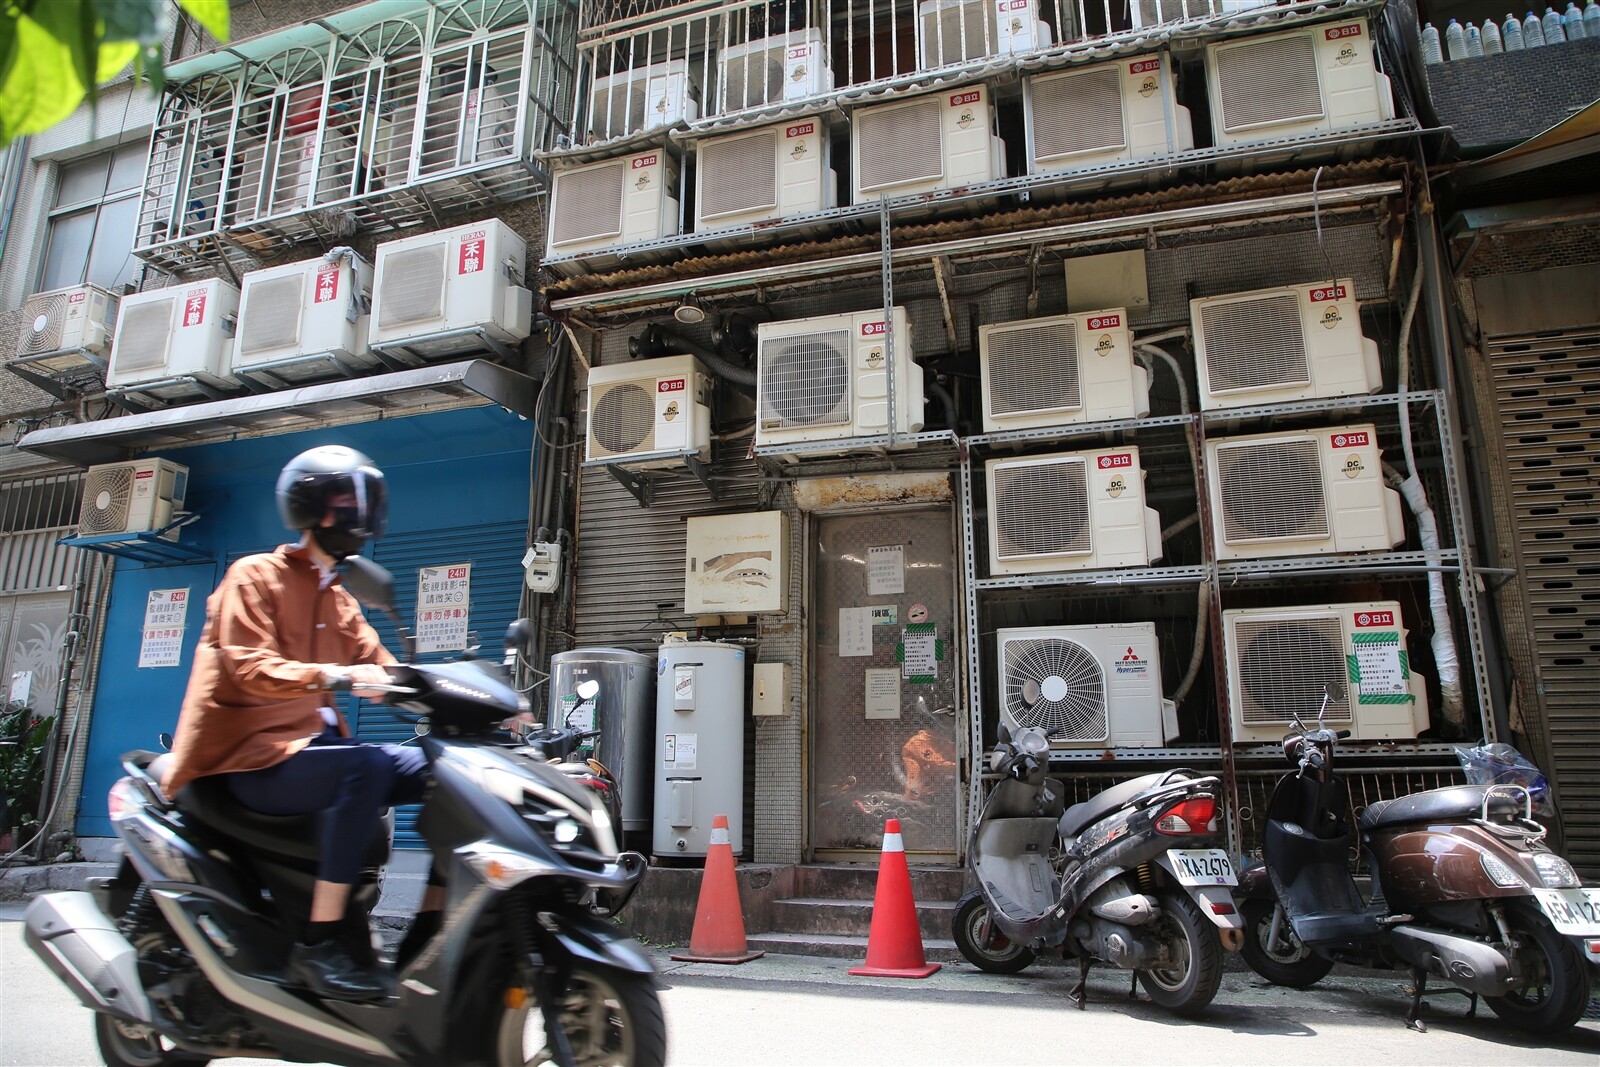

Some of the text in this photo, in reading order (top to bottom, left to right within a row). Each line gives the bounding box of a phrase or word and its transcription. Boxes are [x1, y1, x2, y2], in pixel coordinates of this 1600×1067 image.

[1341, 26, 1359, 36] 日立
[1341, 48, 1353, 56] DC
[964, 93, 979, 102] 日立
[799, 125, 812, 134] 日立
[643, 157, 656, 165] 日立
[461, 230, 486, 242] HERAN
[464, 241, 480, 273] 禾聯
[318, 261, 340, 272] HERAN
[319, 272, 335, 302] 禾聯
[187, 298, 202, 326] 禾聯
[1102, 317, 1118, 326] 日立
[670, 381, 683, 389] 日立
[1348, 434, 1366, 444] 日立
[1113, 455, 1129, 465] 日立
[449, 568, 465, 578] 24H
[422, 580, 467, 593] 監視錄影中
[172, 592, 186, 601] 24H
[1372, 613, 1391, 623] 日立
[1173, 858, 1231, 879] MXA-2679
